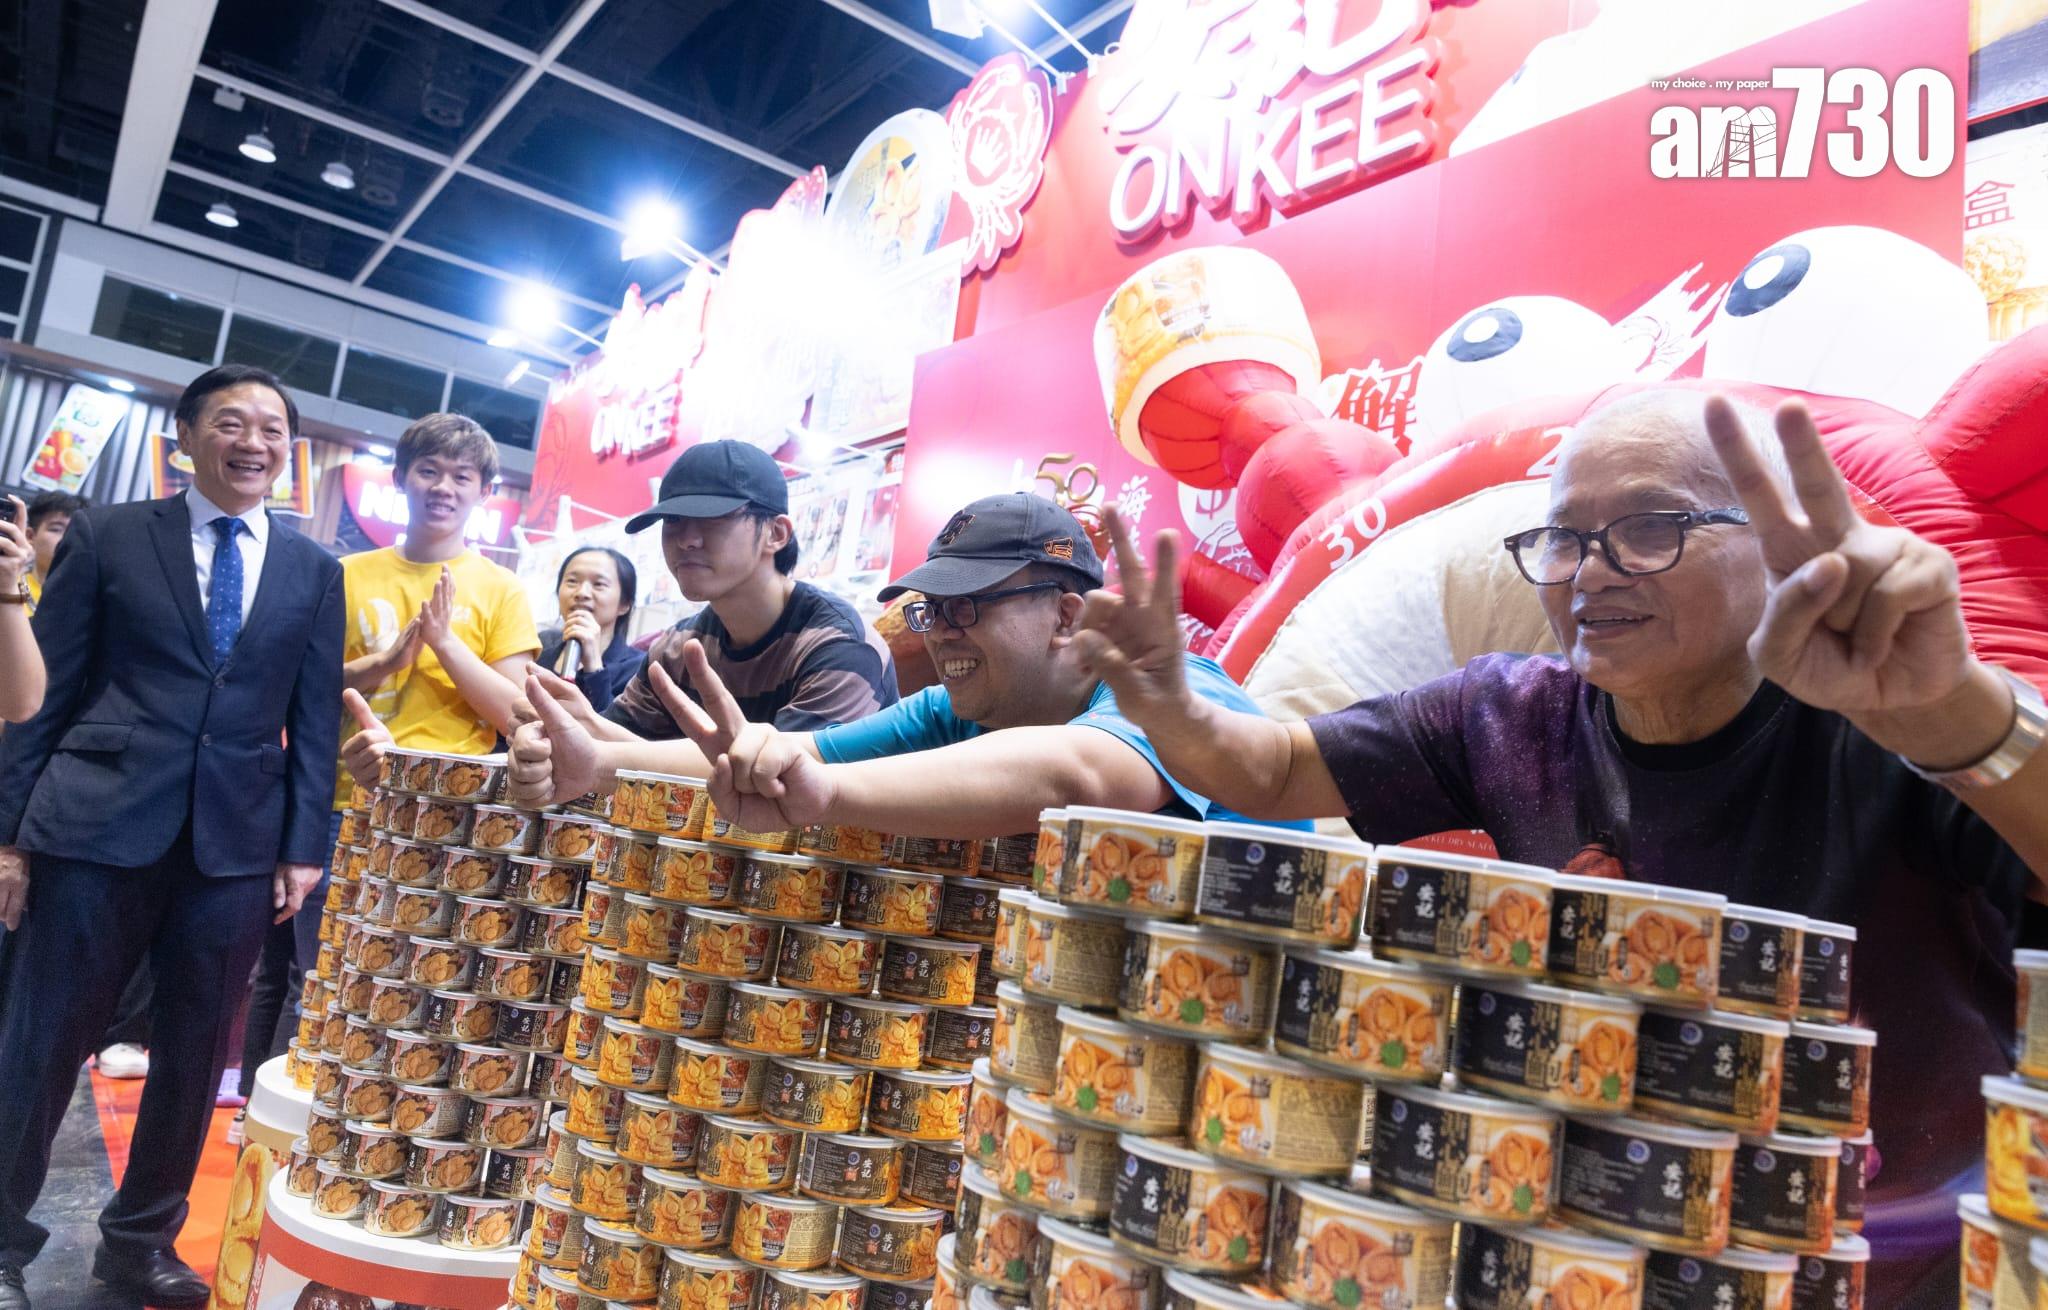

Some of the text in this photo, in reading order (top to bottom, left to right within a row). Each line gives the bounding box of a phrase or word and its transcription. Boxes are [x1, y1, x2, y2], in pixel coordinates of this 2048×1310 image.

[1108, 47, 1430, 234] ONKEE
[1965, 180, 2015, 231] 盒
[1526, 426, 1573, 477] 2
[1318, 497, 1387, 570] 30
